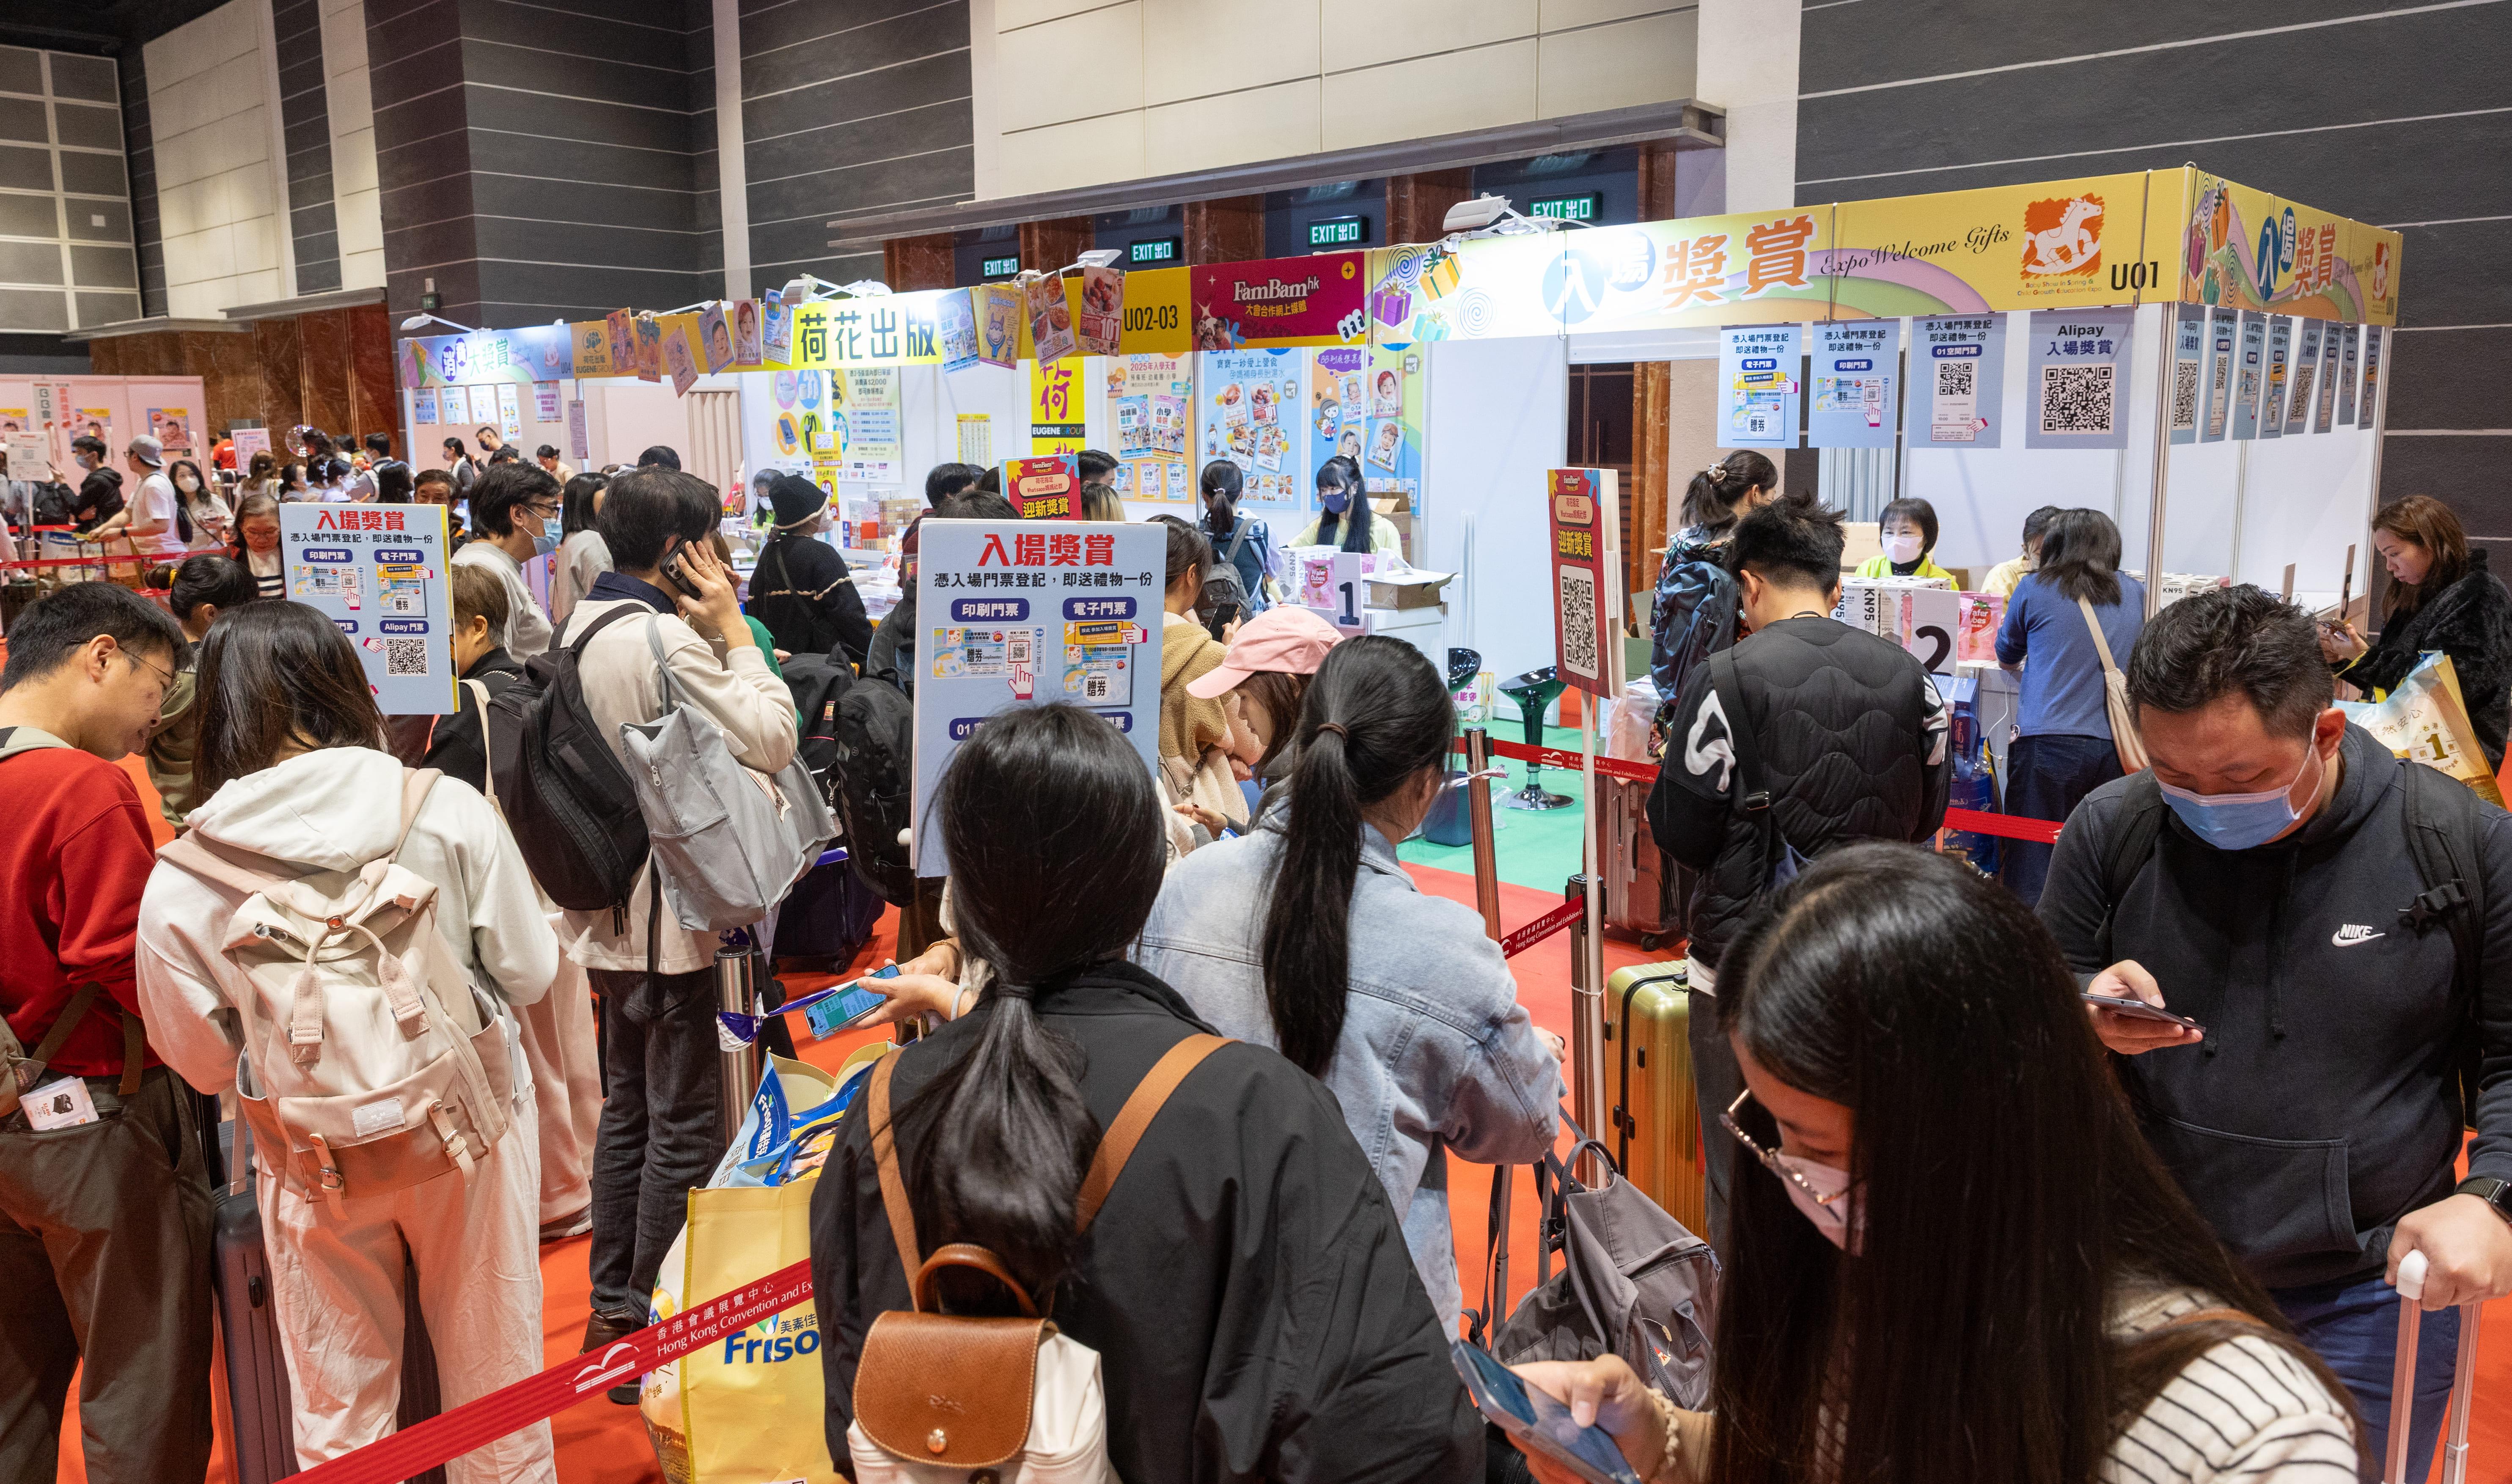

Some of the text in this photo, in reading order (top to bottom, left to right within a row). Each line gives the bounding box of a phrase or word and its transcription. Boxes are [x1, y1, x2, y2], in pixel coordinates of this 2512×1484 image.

[1533, 198, 1591, 217] EXIT 出口
[1311, 223, 1358, 243] EXIT 出口
[1133, 242, 1171, 261] EXIT 出口
[1820, 223, 2012, 278] Expo Welcome Gifts
[2259, 213, 2336, 297] 入場獎賞
[984, 258, 1017, 275] EXIT 出口
[2111, 261, 2158, 291] U01
[1246, 301, 1307, 317] 大會合作網上媒體
[1124, 305, 1178, 332] U02-03
[1926, 319, 1992, 331] 憑入場門票登記
[800, 308, 937, 362] 荷花出版
[1101, 318, 1121, 341] 101
[1825, 330, 1886, 340] 憑入場門票登記
[1929, 332, 1986, 342] 即送禮物一份
[2058, 325, 2104, 338] Alipay
[1732, 333, 1789, 343] 憑入場門票登記
[1736, 345, 1784, 354] 即送禮物一份
[1829, 342, 1880, 352] 即送禮物一份
[2047, 340, 2113, 356] 入場獎賞
[583, 355, 606, 364] 荷花出版
[1130, 362, 1176, 371] 2025年入學天書
[1406, 363, 1417, 372] No.1
[1746, 361, 1772, 369] 電子門票
[1839, 361, 1868, 369] 印刷門票
[1157, 407, 1171, 417] 小學
[1265, 405, 1277, 418] 101
[1032, 426, 1085, 437] EUGENEGROUP
[1751, 419, 1764, 431] 贈券
[1023, 497, 1069, 519] 迎新獎賞
[317, 510, 406, 531] 入場獎賞
[291, 533, 433, 544] 憑入場門票登記，即送禮物一份
[1558, 530, 1592, 557] 迎新獎賞
[309, 551, 346, 560] 印刷門票
[381, 552, 417, 561] 電子門票
[977, 533, 1115, 567] 入場獎賞
[934, 572, 1153, 588] 憑入場門票登記，即送禮物一份
[962, 603, 1019, 617] 印刷門票
[1073, 602, 1127, 616] 電子門票
[1339, 581, 1359, 626] 1
[1864, 588, 1874, 621] KN95
[385, 623, 408, 632] Alipay
[967, 648, 982, 662] 贈券
[1915, 625, 1952, 677] 2
[1087, 680, 1106, 696] 贈券
[957, 724, 970, 736] 01
[2426, 733, 2449, 761] 1
[1516, 941, 1526, 950] Hong
[1526, 936, 1536, 944] Kong
[1536, 923, 1556, 939] Convention
[1562, 910, 1579, 924] Exhibition
[2340, 924, 2373, 939] NIKE
[759, 1094, 772, 1128] Friso
[657, 1282, 774, 1340] 香港會議展覽中心
[657, 1286, 799, 1357] Hong Kong Convention and
[780, 1312, 820, 1334] 美素佳
[724, 1330, 820, 1365] Friso
